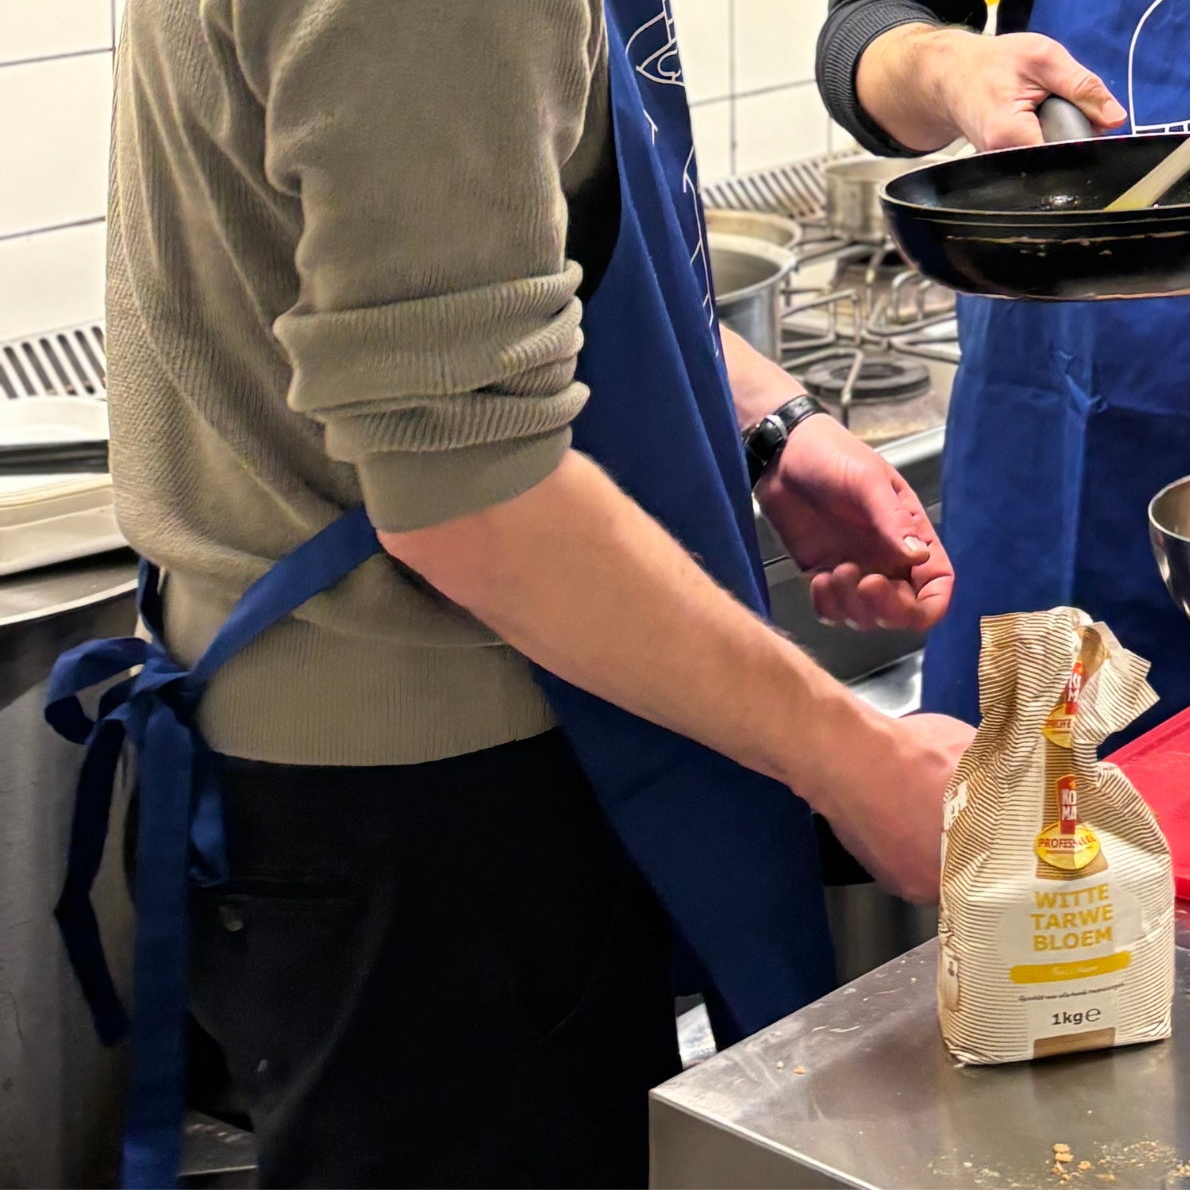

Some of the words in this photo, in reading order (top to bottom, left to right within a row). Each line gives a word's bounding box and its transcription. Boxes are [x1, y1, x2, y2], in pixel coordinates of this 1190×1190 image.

[1034, 883, 1110, 909] WITTE
[1030, 904, 1114, 931] TARWE
[1033, 926, 1113, 952] BLOEM
